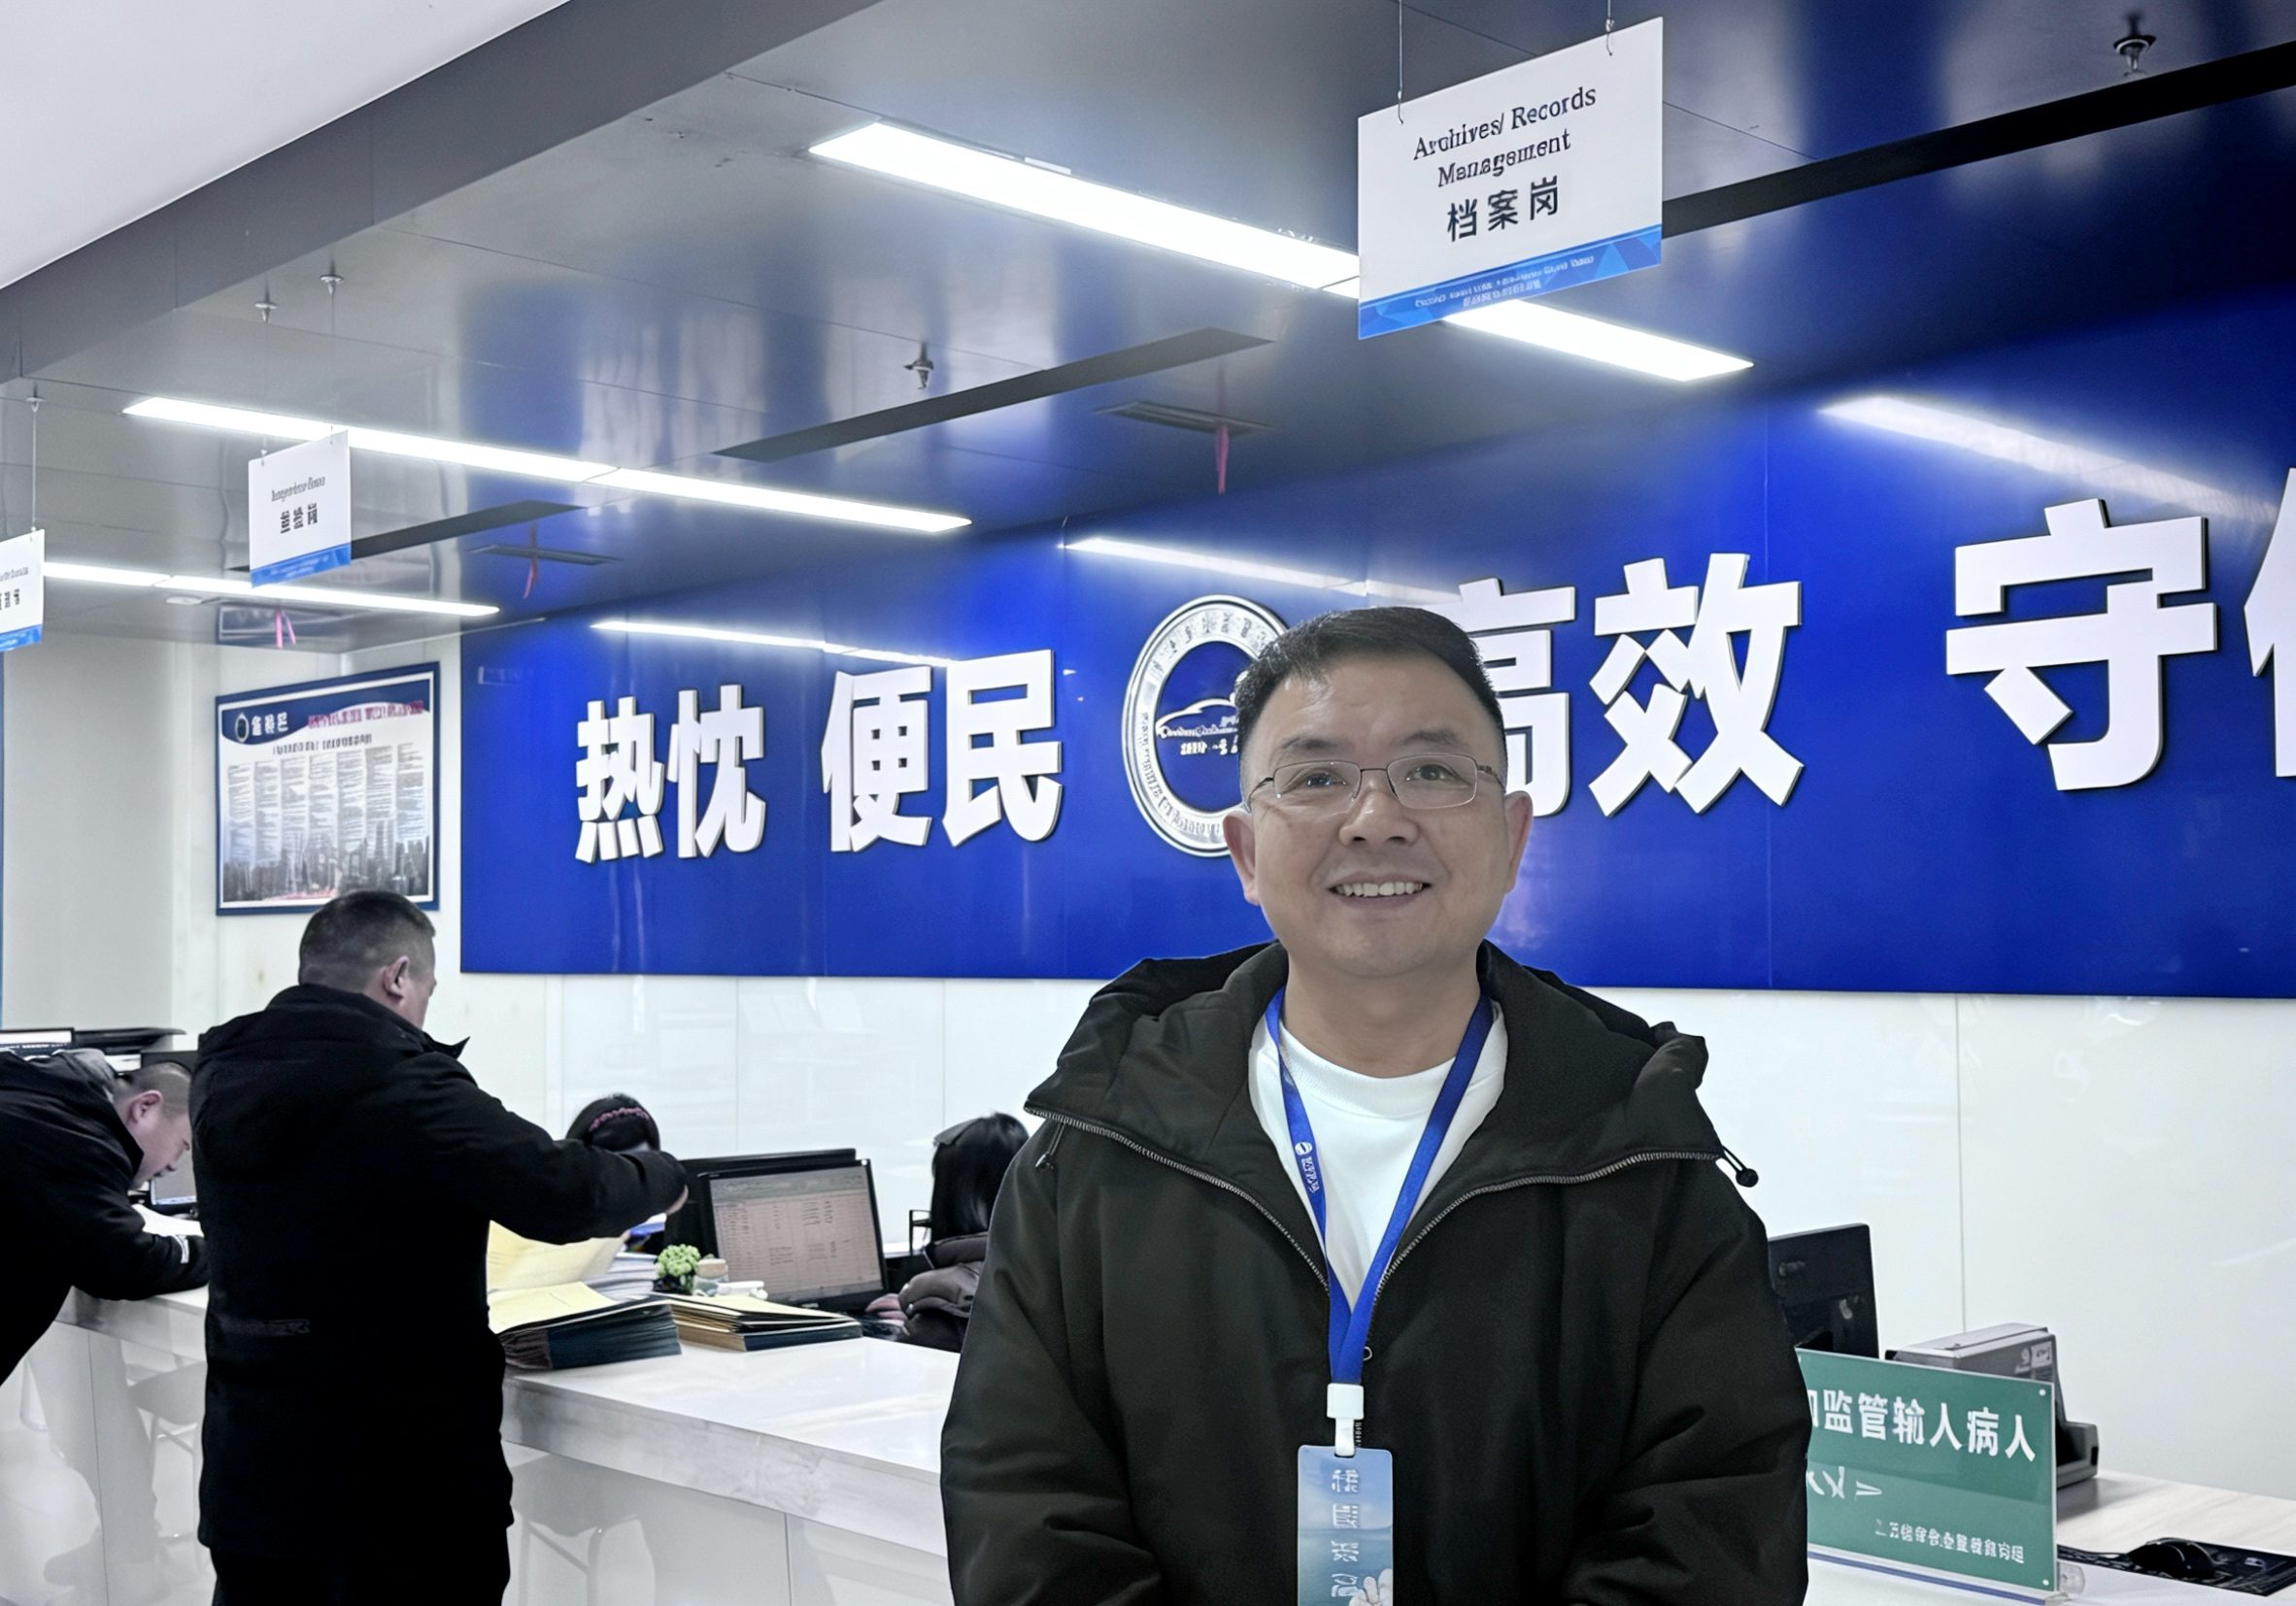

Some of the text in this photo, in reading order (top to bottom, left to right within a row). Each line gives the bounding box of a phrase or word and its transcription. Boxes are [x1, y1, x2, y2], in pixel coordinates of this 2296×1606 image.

[1511, 85, 1597, 130] Records
[1437, 128, 1571, 187] Management
[1447, 175, 1558, 242] 档案岗
[575, 684, 765, 863] 热忱
[821, 649, 1063, 853] 便民
[1428, 553, 1805, 818] 高效
